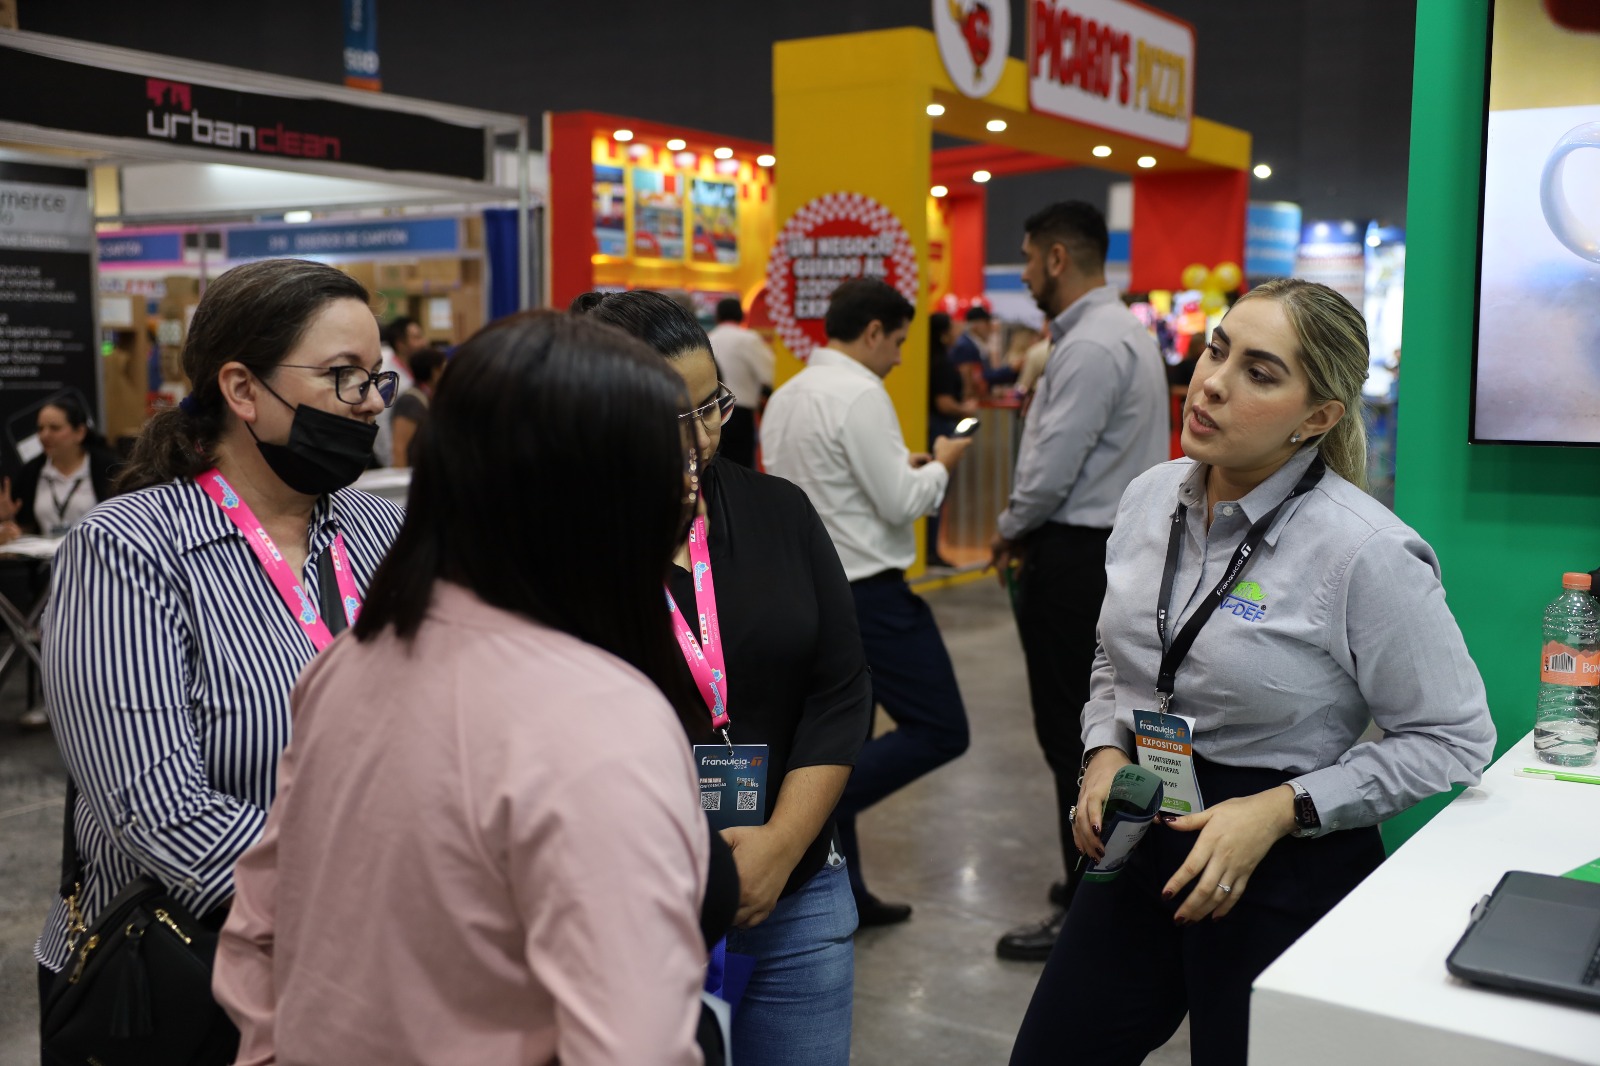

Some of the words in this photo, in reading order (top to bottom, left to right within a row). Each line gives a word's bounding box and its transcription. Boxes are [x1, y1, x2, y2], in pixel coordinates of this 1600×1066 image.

[1134, 38, 1186, 123] PIZZA
[147, 109, 341, 159] urbanclean
[1142, 737, 1184, 752] EXPOSITOR
